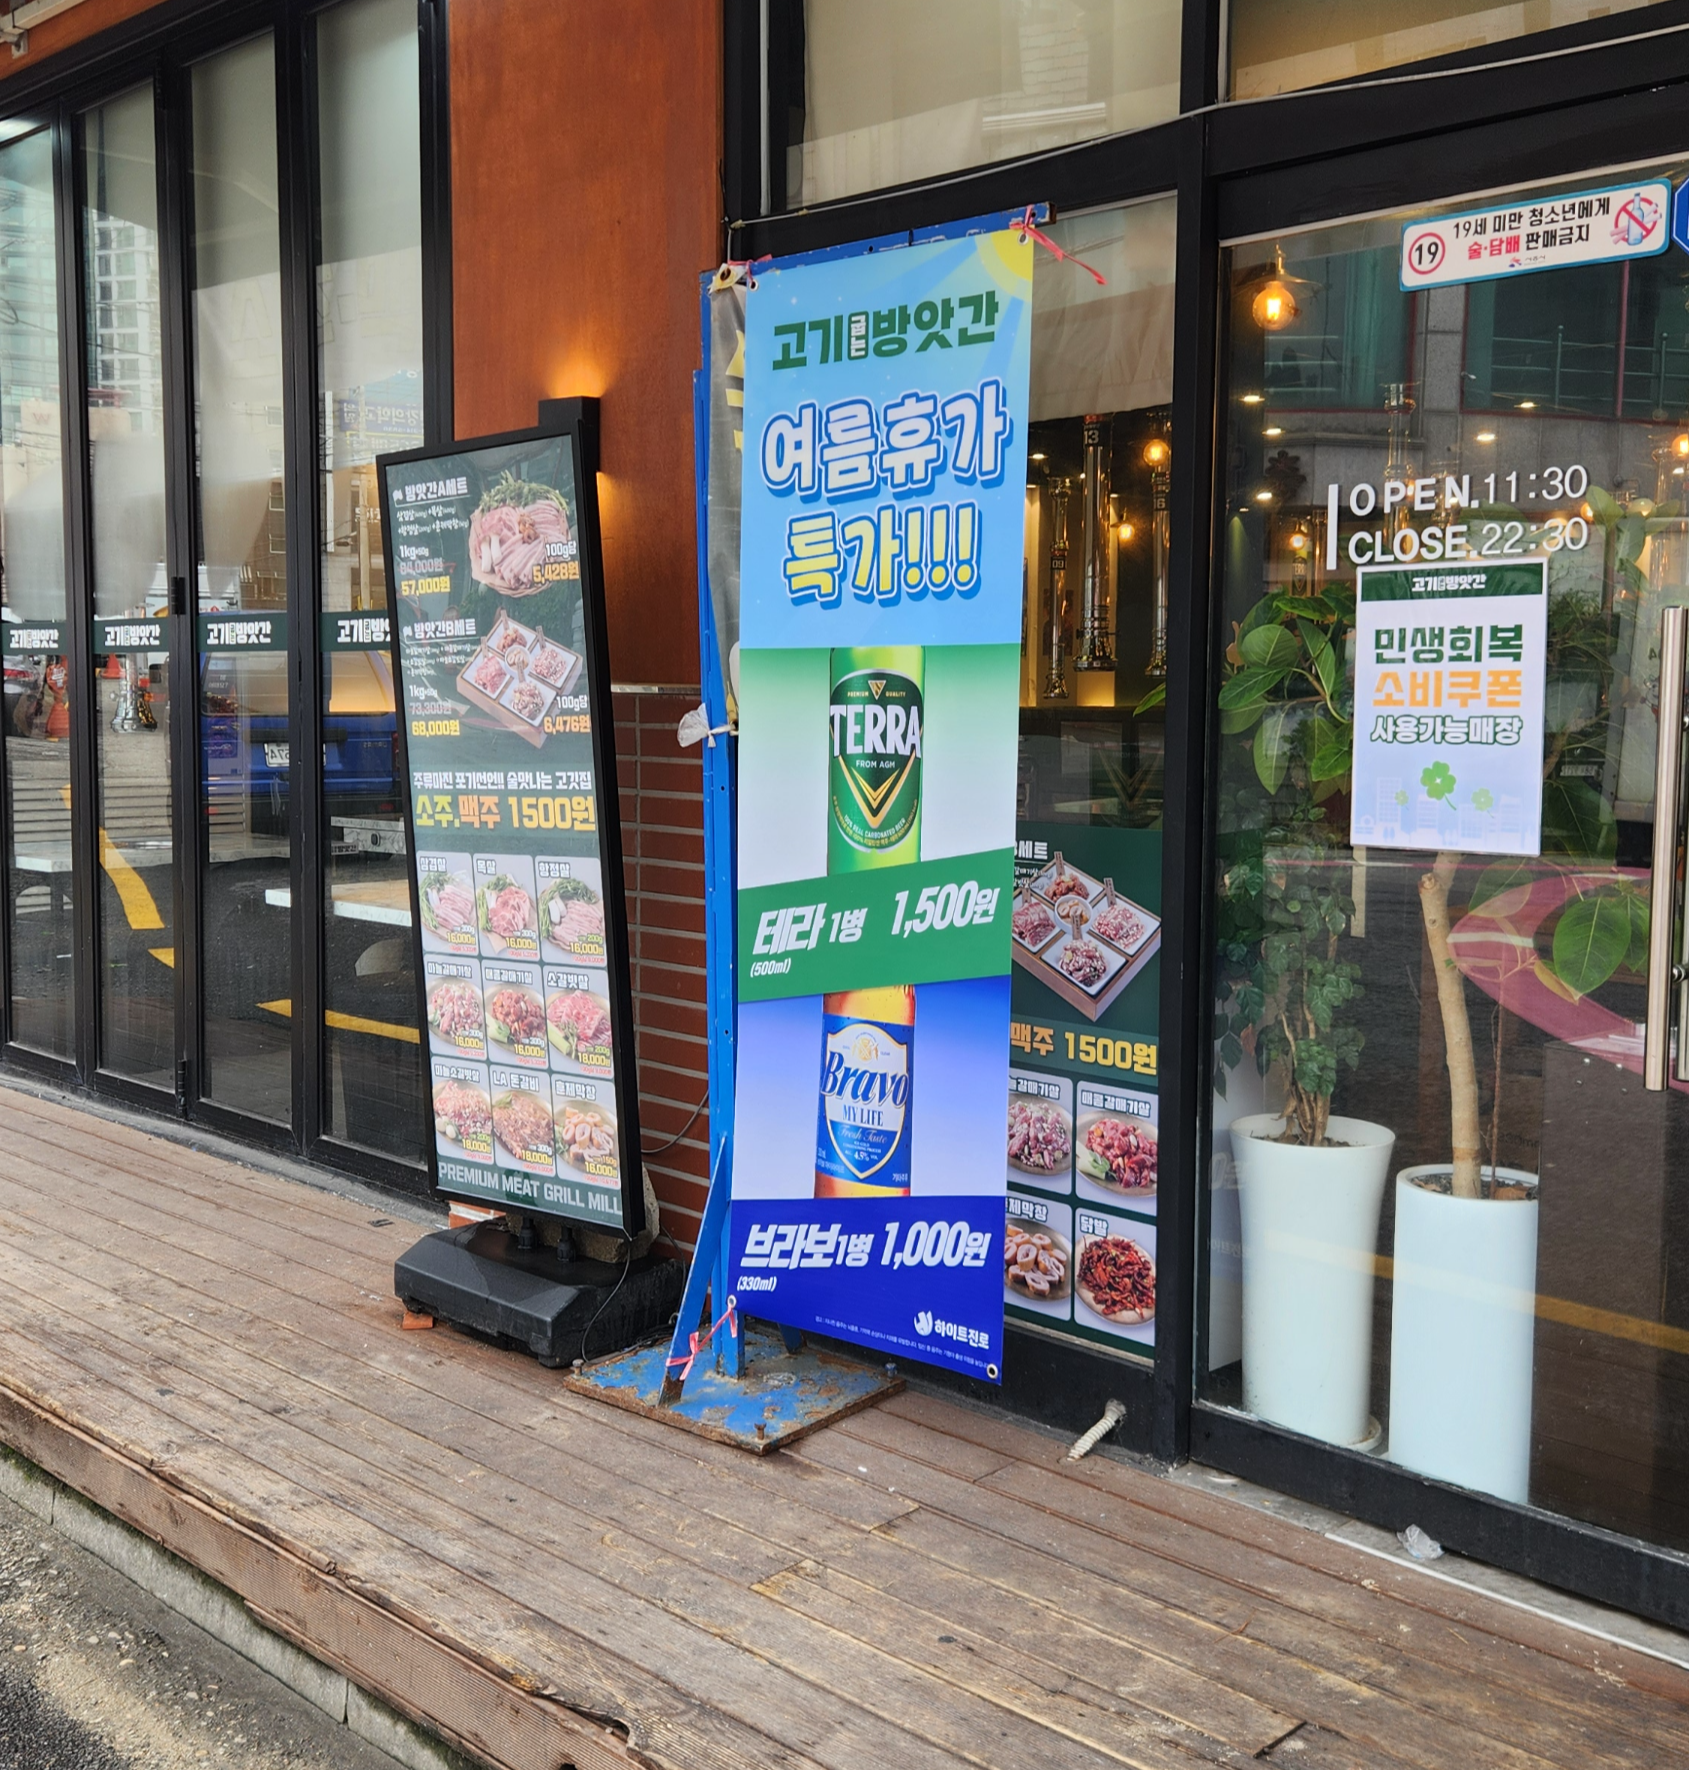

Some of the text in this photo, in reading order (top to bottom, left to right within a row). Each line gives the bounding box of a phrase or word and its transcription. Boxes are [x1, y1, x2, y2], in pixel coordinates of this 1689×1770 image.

[1453, 197, 1611, 239] 19세 미만 청소년에게
[1525, 224, 1590, 250] 판매금지
[1415, 241, 1439, 266] 19
[761, 378, 1011, 498] 여름휴가
[1084, 429, 1099, 444] 13
[405, 477, 468, 502] 방앗간A세트
[1484, 465, 1588, 504] 11:30
[545, 540, 577, 558] 100g당
[783, 502, 982, 604] 특가!!!
[1348, 517, 1589, 564] CLOSE. 22:30
[533, 560, 580, 584] 5,428원
[1052, 559, 1064, 569] 09
[401, 575, 451, 596] 57,000원
[414, 618, 477, 639] 방앗간B세트
[1374, 624, 1524, 665] 민생회복
[1372, 669, 1522, 709] 소비쿠폰
[556, 694, 588, 712] 100g당
[412, 719, 460, 737] 68,000원
[543, 714, 591, 735] 6,476원
[830, 704, 921, 759] TERRA
[1370, 715, 1524, 746] 사용가능매장
[856, 760, 876, 768] FROM
[413, 771, 592, 790] 주류마진 포기선언!! 술맛나는 고깃집
[508, 795, 596, 832] 1500원
[476, 858, 496, 875] 목살
[538, 861, 571, 879] 항정살
[752, 880, 1000, 955] 테라 1병 1,500원
[750, 957, 791, 978] (500ml)
[1011, 1022, 1157, 1076] 맥주 1500원
[493, 1071, 539, 1091] LA 돈갈비
[555, 1080, 596, 1100] 훈제막창
[820, 1051, 909, 1109] Bravo
[843, 1104, 884, 1127] MY LIFE
[1080, 1089, 1151, 1117] 매콤갈매기살
[837, 1125, 887, 1144] Fresh Taste
[438, 1162, 499, 1190] PREMIUM
[502, 1175, 540, 1198] MEAT
[543, 1182, 585, 1208] GRILL
[588, 1191, 623, 1216] MILL
[1006, 1197, 1048, 1222] 제막창
[1079, 1214, 1108, 1238] 닭발
[880, 1221, 992, 1270] 1,000원
[736, 1276, 777, 1292] (330ml)
[934, 1319, 989, 1350] 하이트진로
